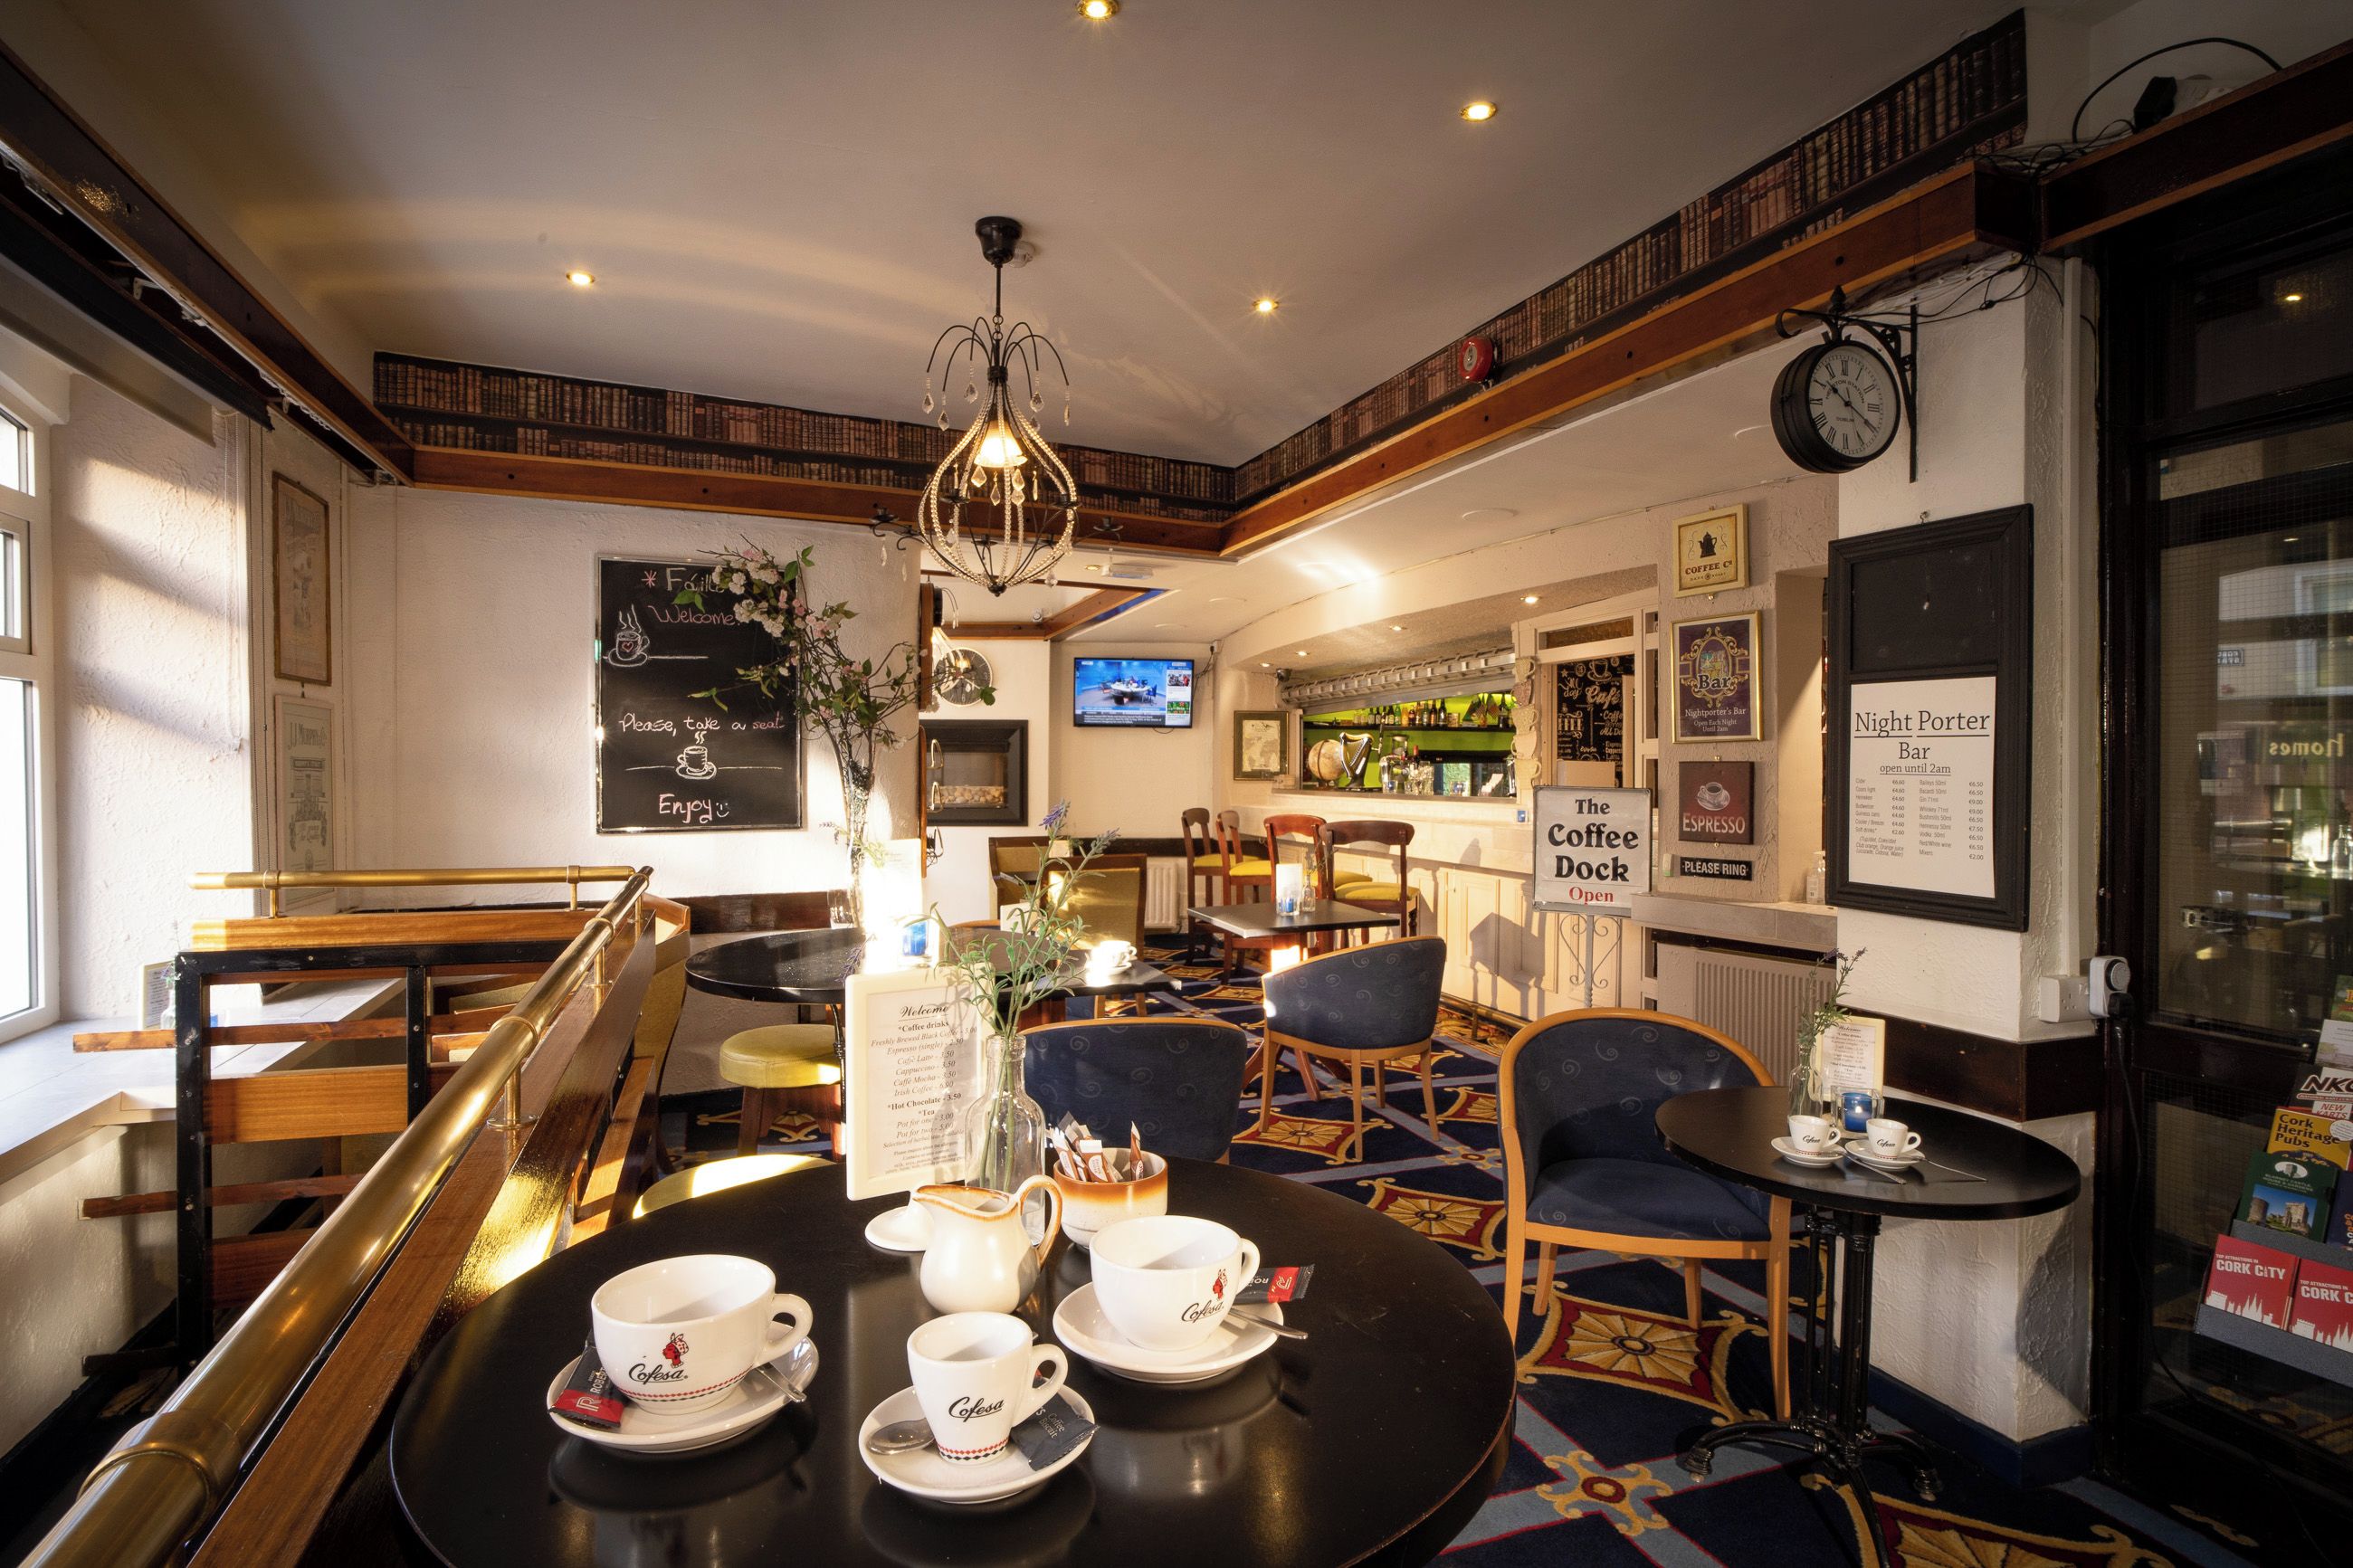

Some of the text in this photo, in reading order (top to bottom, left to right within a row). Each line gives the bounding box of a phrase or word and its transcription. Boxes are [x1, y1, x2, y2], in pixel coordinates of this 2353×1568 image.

[1847, 380, 1866, 404] STATION
[1685, 562, 1720, 575] COFFEE
[1698, 674, 1731, 689] Bar
[1685, 707, 1746, 718] Nightporter's Bar
[683, 716, 720, 730] take
[731, 721, 746, 730] a
[1722, 718, 1738, 727] Night
[1855, 710, 1990, 738] Night Porter
[1899, 742, 1930, 760] Bar
[1880, 763, 1951, 774] open until 2am
[659, 794, 713, 824] Enjoy
[1575, 798, 1611, 814] The
[1682, 813, 1746, 833] ESPRESSO
[1548, 822, 1639, 850] Coffee
[1555, 855, 1630, 882] Dock
[1683, 860, 1747, 876] PLEASE RING
[1568, 886, 1614, 905] Open
[900, 1004, 948, 1019] Welcome
[926, 1021, 949, 1030] drinks
[871, 1038, 895, 1047] Freshly
[896, 1034, 920, 1043] Brewed
[921, 1031, 938, 1041] Black
[887, 1046, 918, 1056] Espresso
[919, 1041, 943, 1051] (single)
[917, 1053, 934, 1063] Latte
[895, 1064, 936, 1076] Cappuccino
[913, 1074, 937, 1084] Mocha
[894, 1085, 932, 1097] Irish Coffee
[906, 1096, 941, 1108] Chocolate
[947, 1092, 962, 1102] 3.50
[2320, 1103, 2346, 1111] NEW
[896, 1121, 909, 1129] Pot
[910, 1119, 919, 1128] for
[939, 1112, 954, 1122] 3.00
[2278, 1114, 2314, 1129] Cork
[896, 1131, 909, 1139] Pot
[909, 1129, 919, 1138] for
[2274, 1133, 2310, 1148] Pubs
[2277, 1123, 2341, 1145] Heritage
[883, 1140, 907, 1149] Selection
[2224, 1255, 2253, 1263] ATTRACTIONS
[2215, 1259, 2286, 1279] CORK CITY
[2310, 1280, 2342, 1290] ATTRACTIONS
[2301, 1286, 2340, 1303] CORK
[1181, 1299, 1224, 1323] Cofesa
[629, 1363, 685, 1384] Cofesa
[948, 1396, 1005, 1422] Cofesa
[1040, 1416, 1059, 1440] Biscuit
[1047, 1412, 1065, 1433] Coffee
